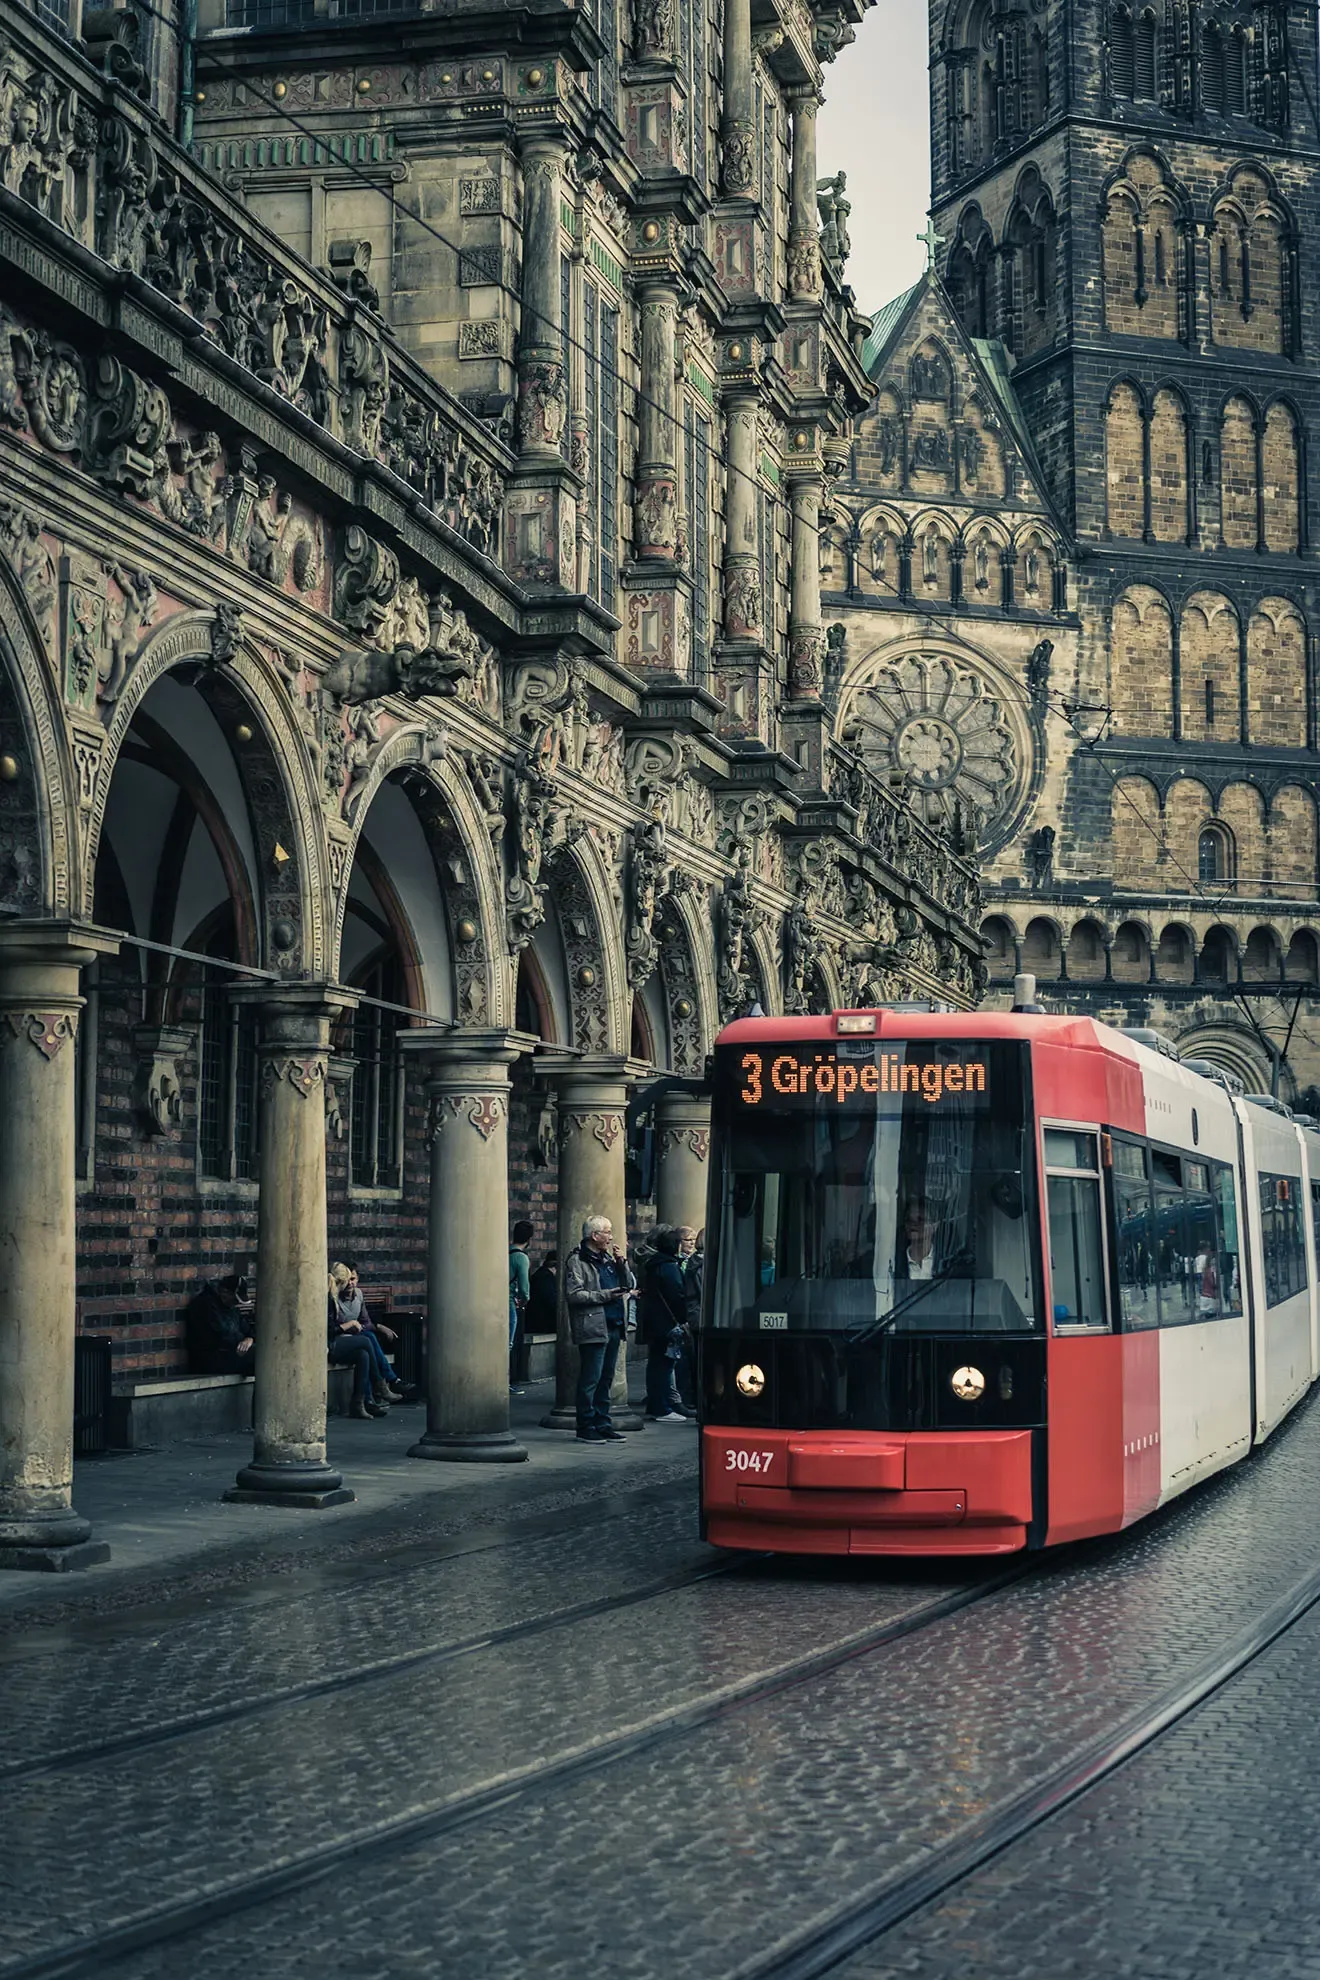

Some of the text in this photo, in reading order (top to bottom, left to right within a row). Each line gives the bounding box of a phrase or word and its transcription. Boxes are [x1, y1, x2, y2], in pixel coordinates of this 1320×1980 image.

[741, 1053, 986, 1104] 3 Gröpelingen
[763, 1315, 785, 1328] 5017
[724, 1449, 774, 1473] 3047
